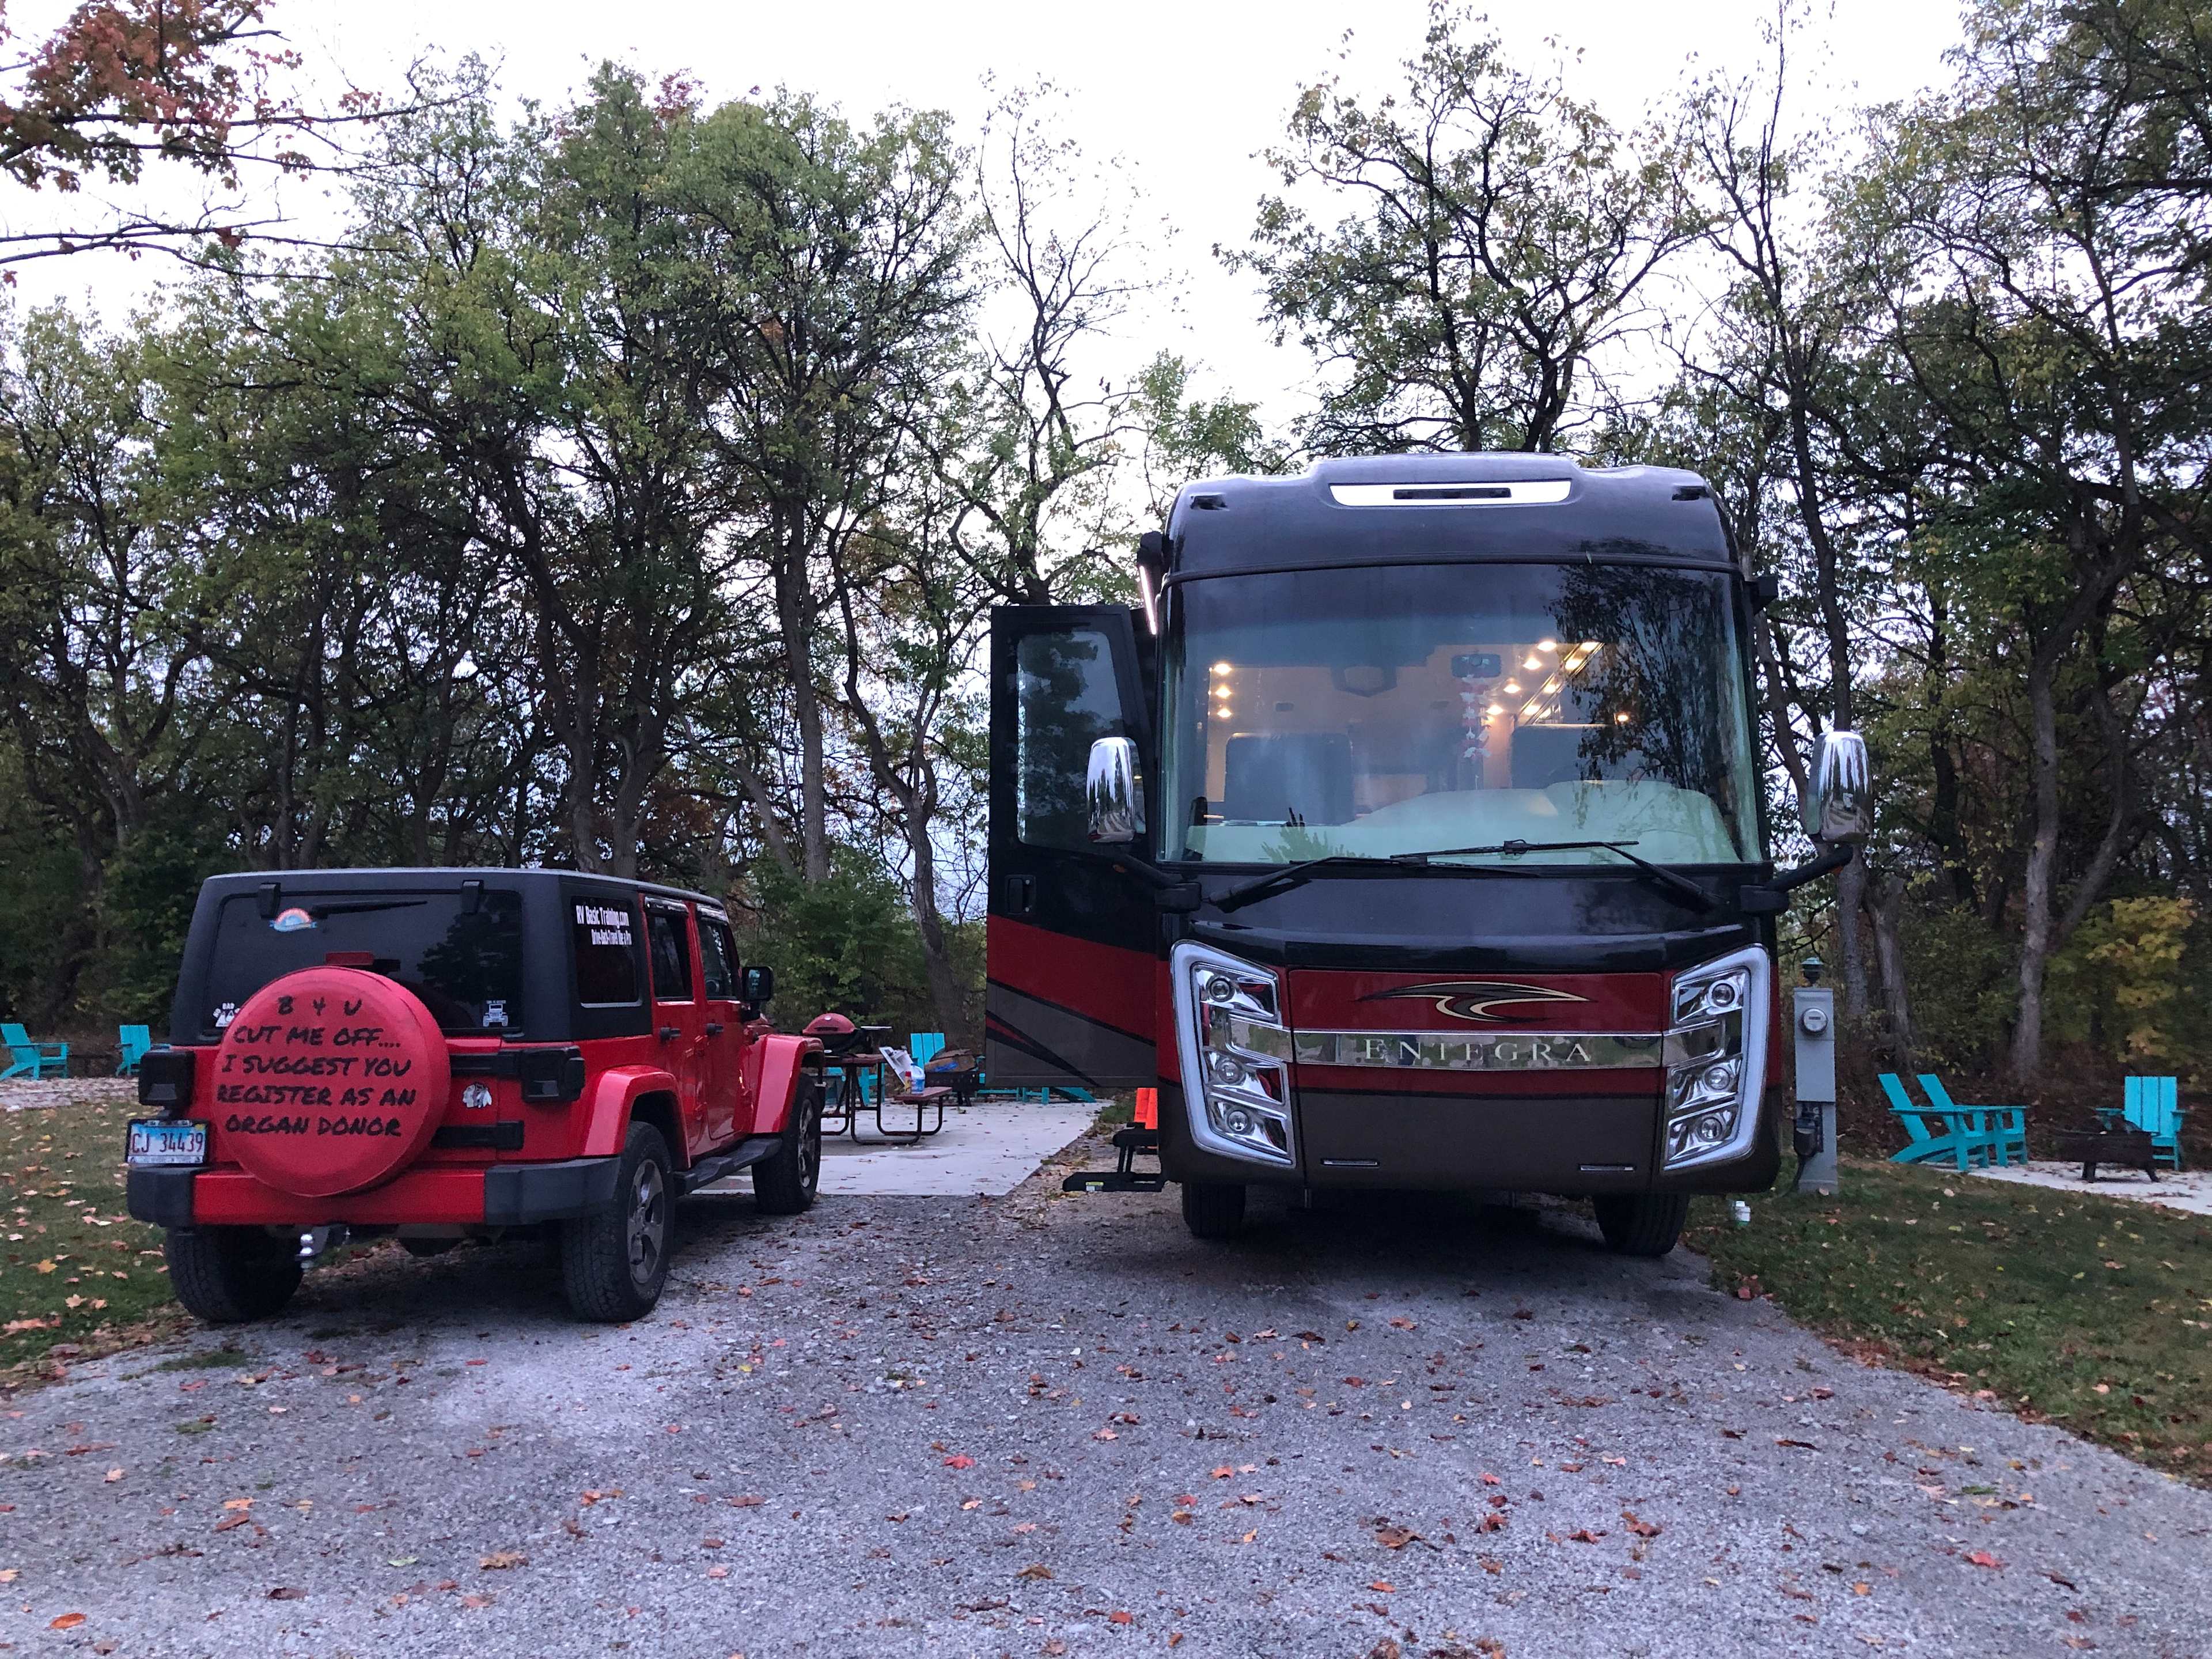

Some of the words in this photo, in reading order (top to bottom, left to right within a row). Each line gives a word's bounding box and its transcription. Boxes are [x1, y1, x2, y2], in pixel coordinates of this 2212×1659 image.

[576, 905, 584, 924] RV
[585, 906, 600, 925] Basic
[278, 996, 294, 1015] B
[313, 997, 325, 1016] 4
[344, 998, 362, 1016] U
[234, 1025, 282, 1043] CUT
[286, 1027, 325, 1046] ME
[1364, 1038, 1592, 1062] ENTEGRA
[221, 1054, 237, 1073] I
[243, 1055, 359, 1076] SUGGEST
[364, 1058, 411, 1077] YOU
[217, 1084, 332, 1106] REGISTER
[340, 1087, 374, 1106] AS
[379, 1088, 416, 1106] AN
[225, 1114, 310, 1134] ORGAN
[317, 1116, 402, 1137] DONOR
[132, 1133, 149, 1153] CJ
[159, 1132, 203, 1153] 34439
